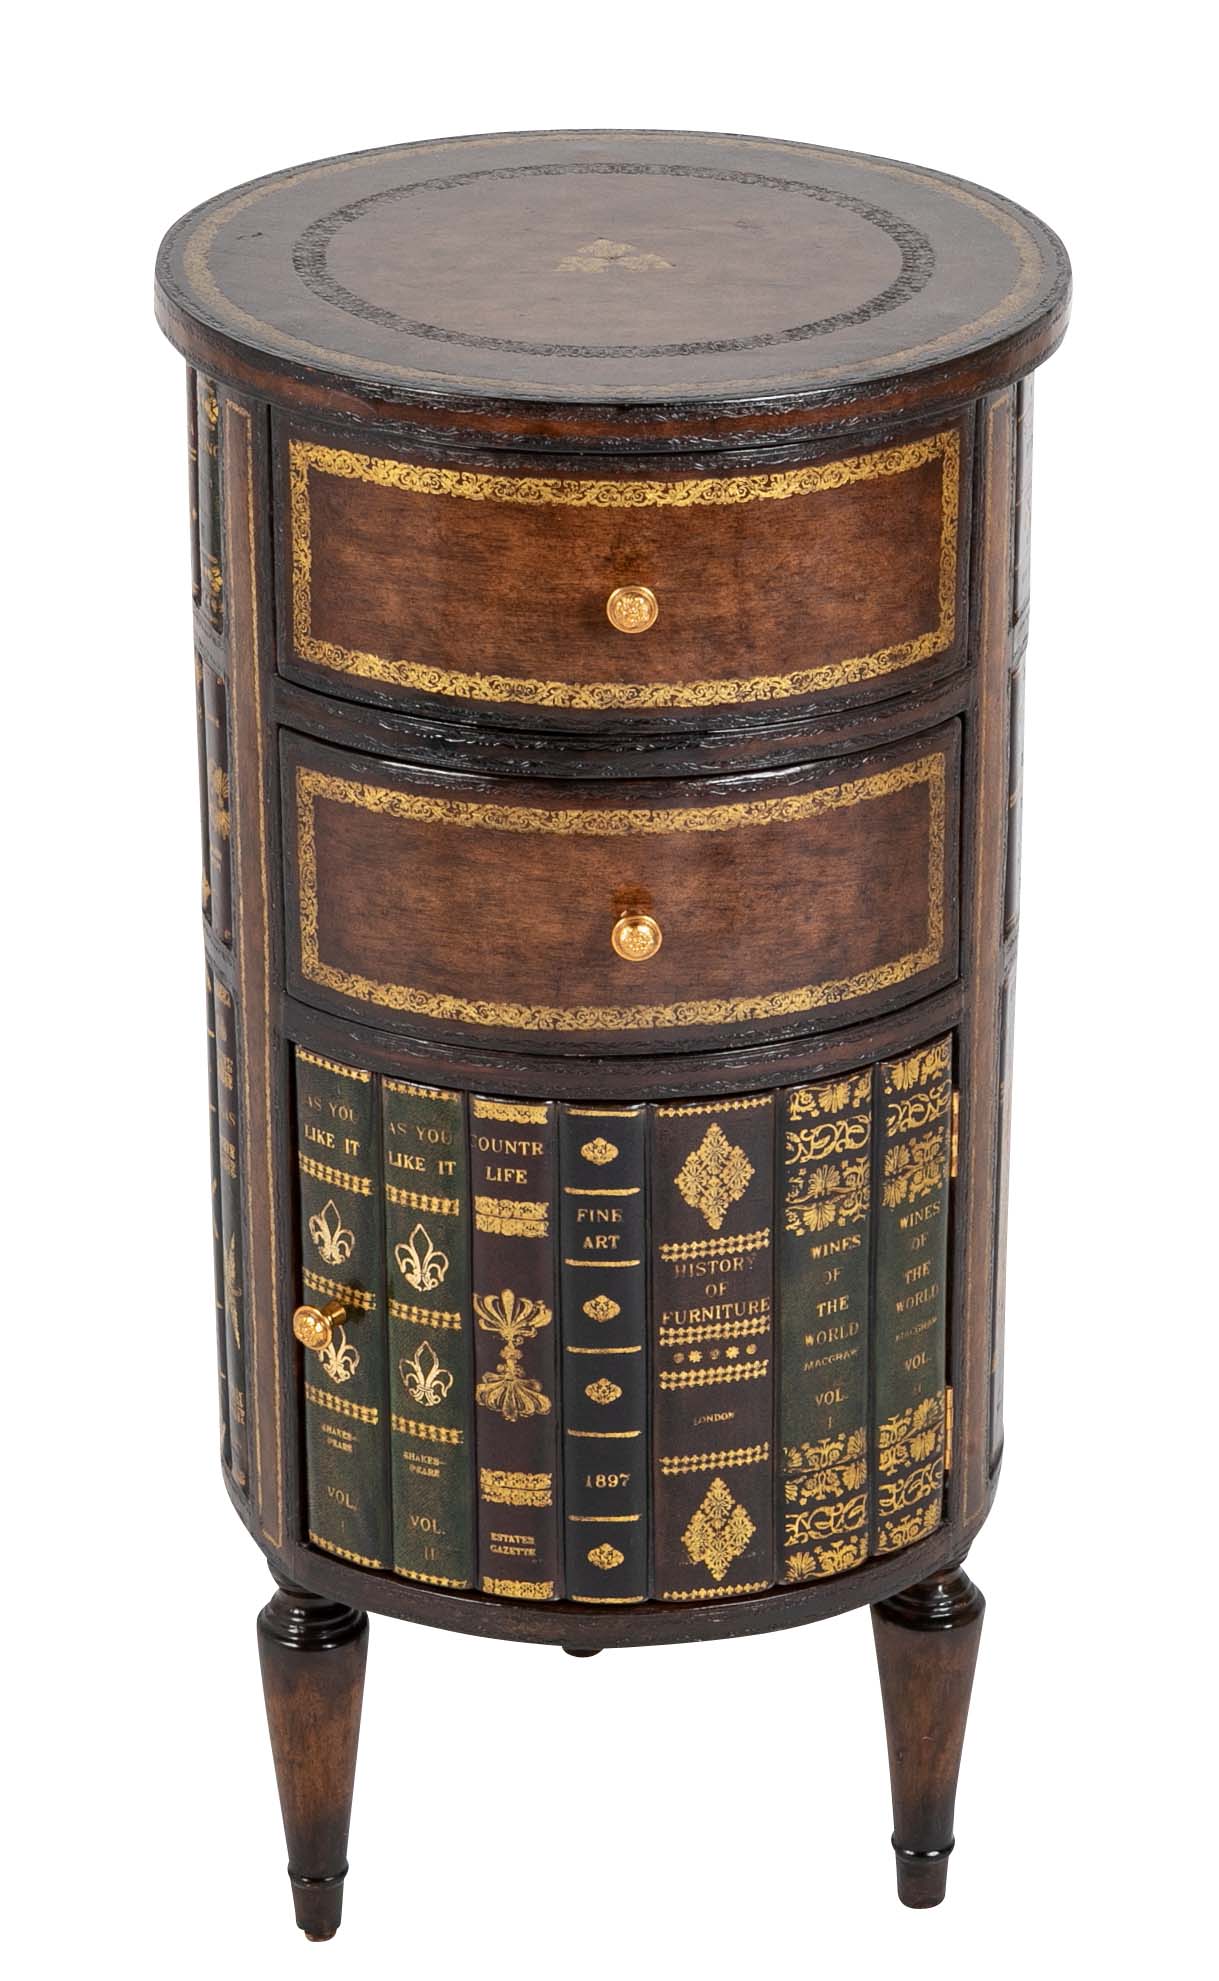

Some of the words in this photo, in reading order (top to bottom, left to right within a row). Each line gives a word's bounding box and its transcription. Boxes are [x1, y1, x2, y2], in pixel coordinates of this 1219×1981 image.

[304, 1124, 336, 1149] LIKE
[344, 1138, 361, 1156] IT
[389, 1122, 407, 1135] AS
[416, 1126, 453, 1145] YOU
[388, 1150, 426, 1172] LIKE
[438, 1160, 457, 1176] IT
[486, 1166, 528, 1185] LIFE
[577, 1208, 623, 1223] FINE
[900, 1200, 941, 1230] WINES
[583, 1234, 621, 1249] ART
[810, 1234, 861, 1260] WINES
[912, 1232, 929, 1250] OF
[903, 1259, 932, 1285] THE
[705, 1281, 728, 1298] OF
[896, 1284, 940, 1313] WORLD
[662, 1297, 770, 1325] FURNITURE
[816, 1294, 849, 1318] THE
[804, 1321, 860, 1347] WORLD
[693, 1411, 736, 1426] LONDON
[585, 1472, 631, 1489] 1897
[490, 1532, 535, 1545] ESTATES
[490, 1544, 536, 1557] GAZETTE
